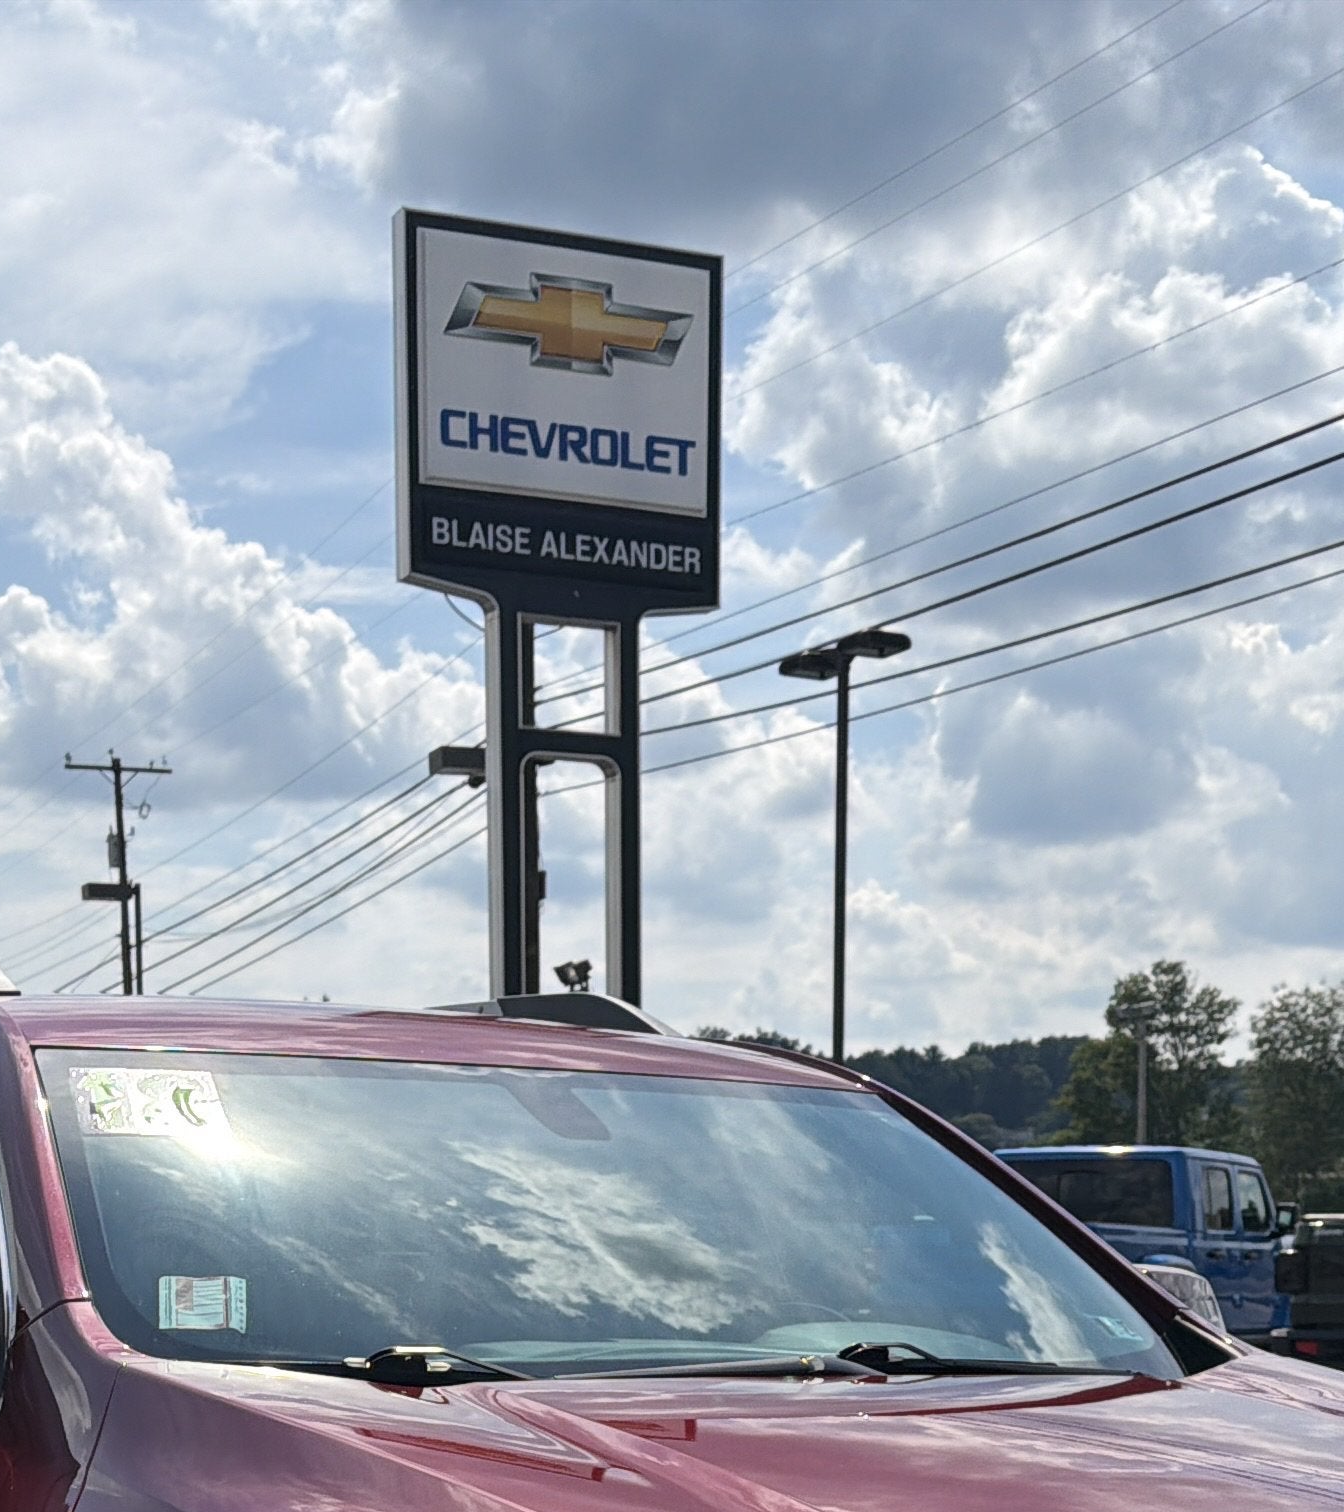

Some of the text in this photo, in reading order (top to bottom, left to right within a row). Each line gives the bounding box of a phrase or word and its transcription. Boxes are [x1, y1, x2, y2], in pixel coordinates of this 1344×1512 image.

[439, 408, 696, 476] CHEVROLET
[431, 516, 702, 574] BLAISE ALEXANDER
